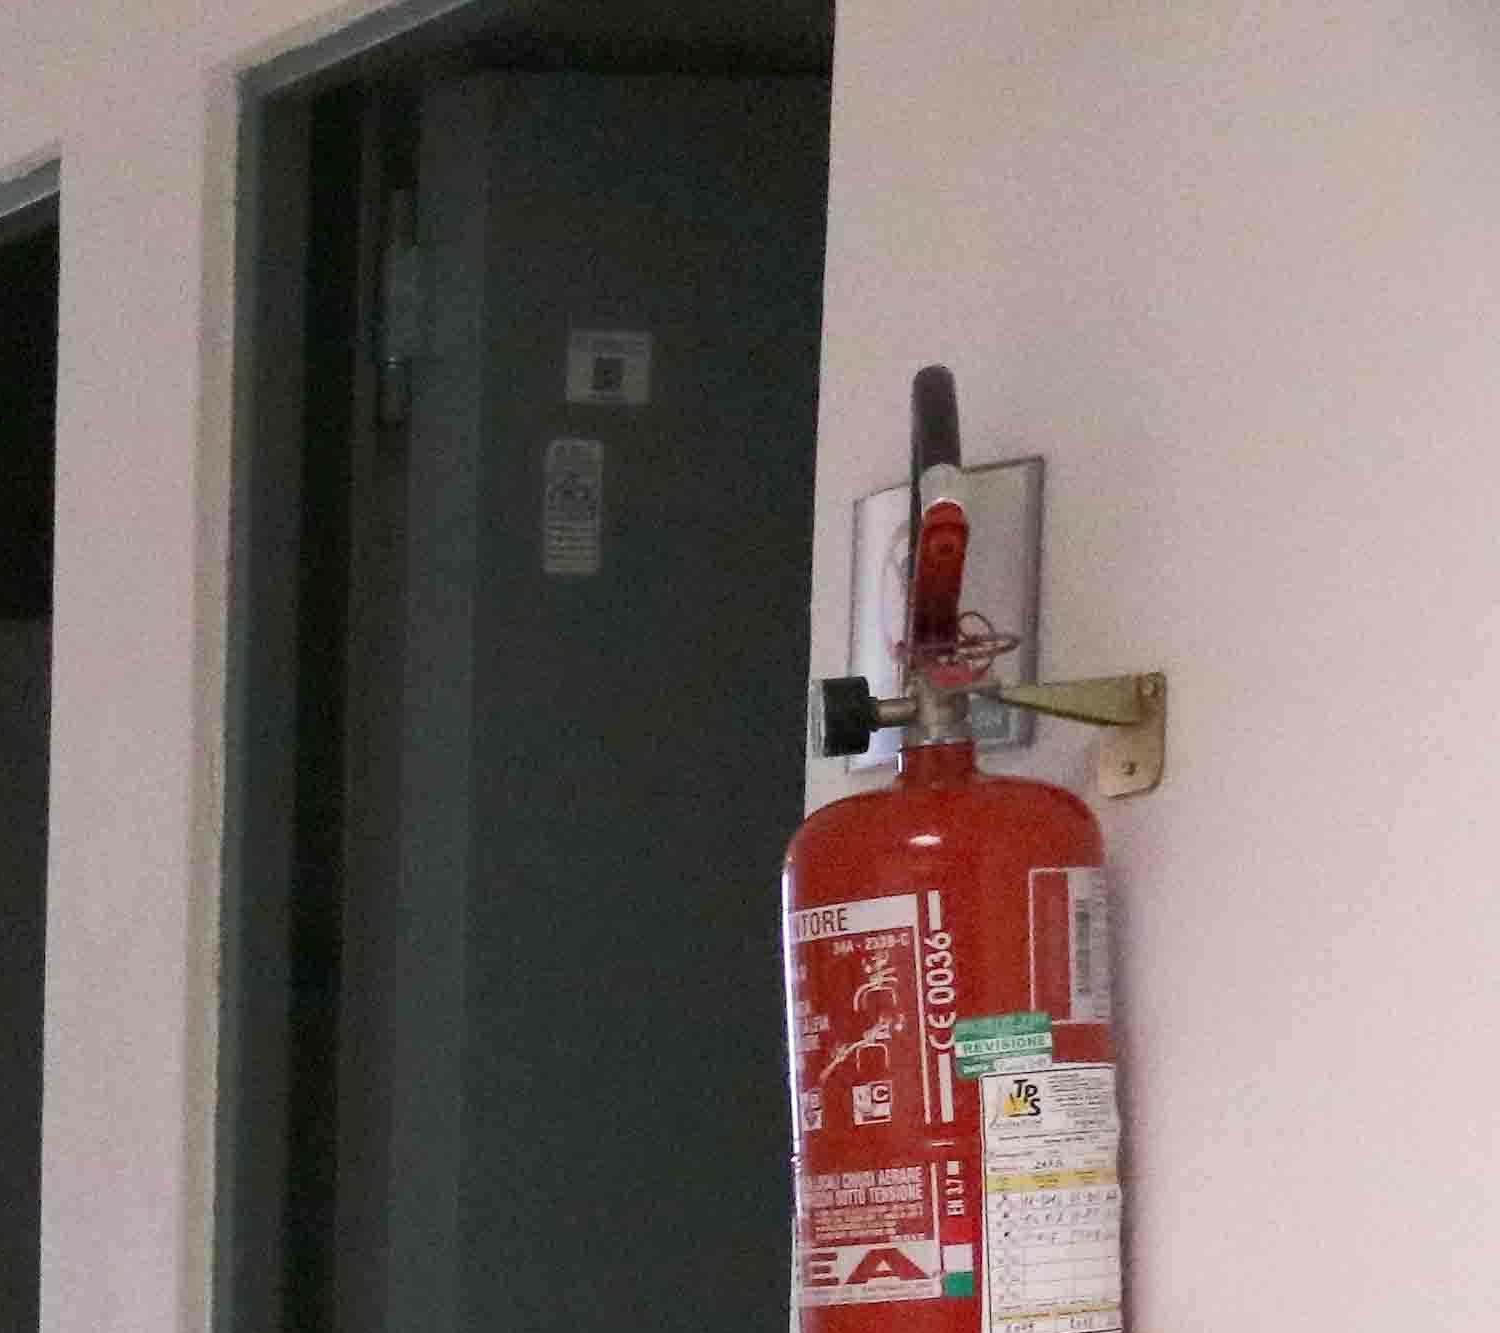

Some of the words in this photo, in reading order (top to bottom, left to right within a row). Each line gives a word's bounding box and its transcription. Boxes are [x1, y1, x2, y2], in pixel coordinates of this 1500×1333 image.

[797, 907, 849, 937] TORE
[924, 931, 955, 1005] 0036
[963, 1038, 1046, 1055] REVISIONE
